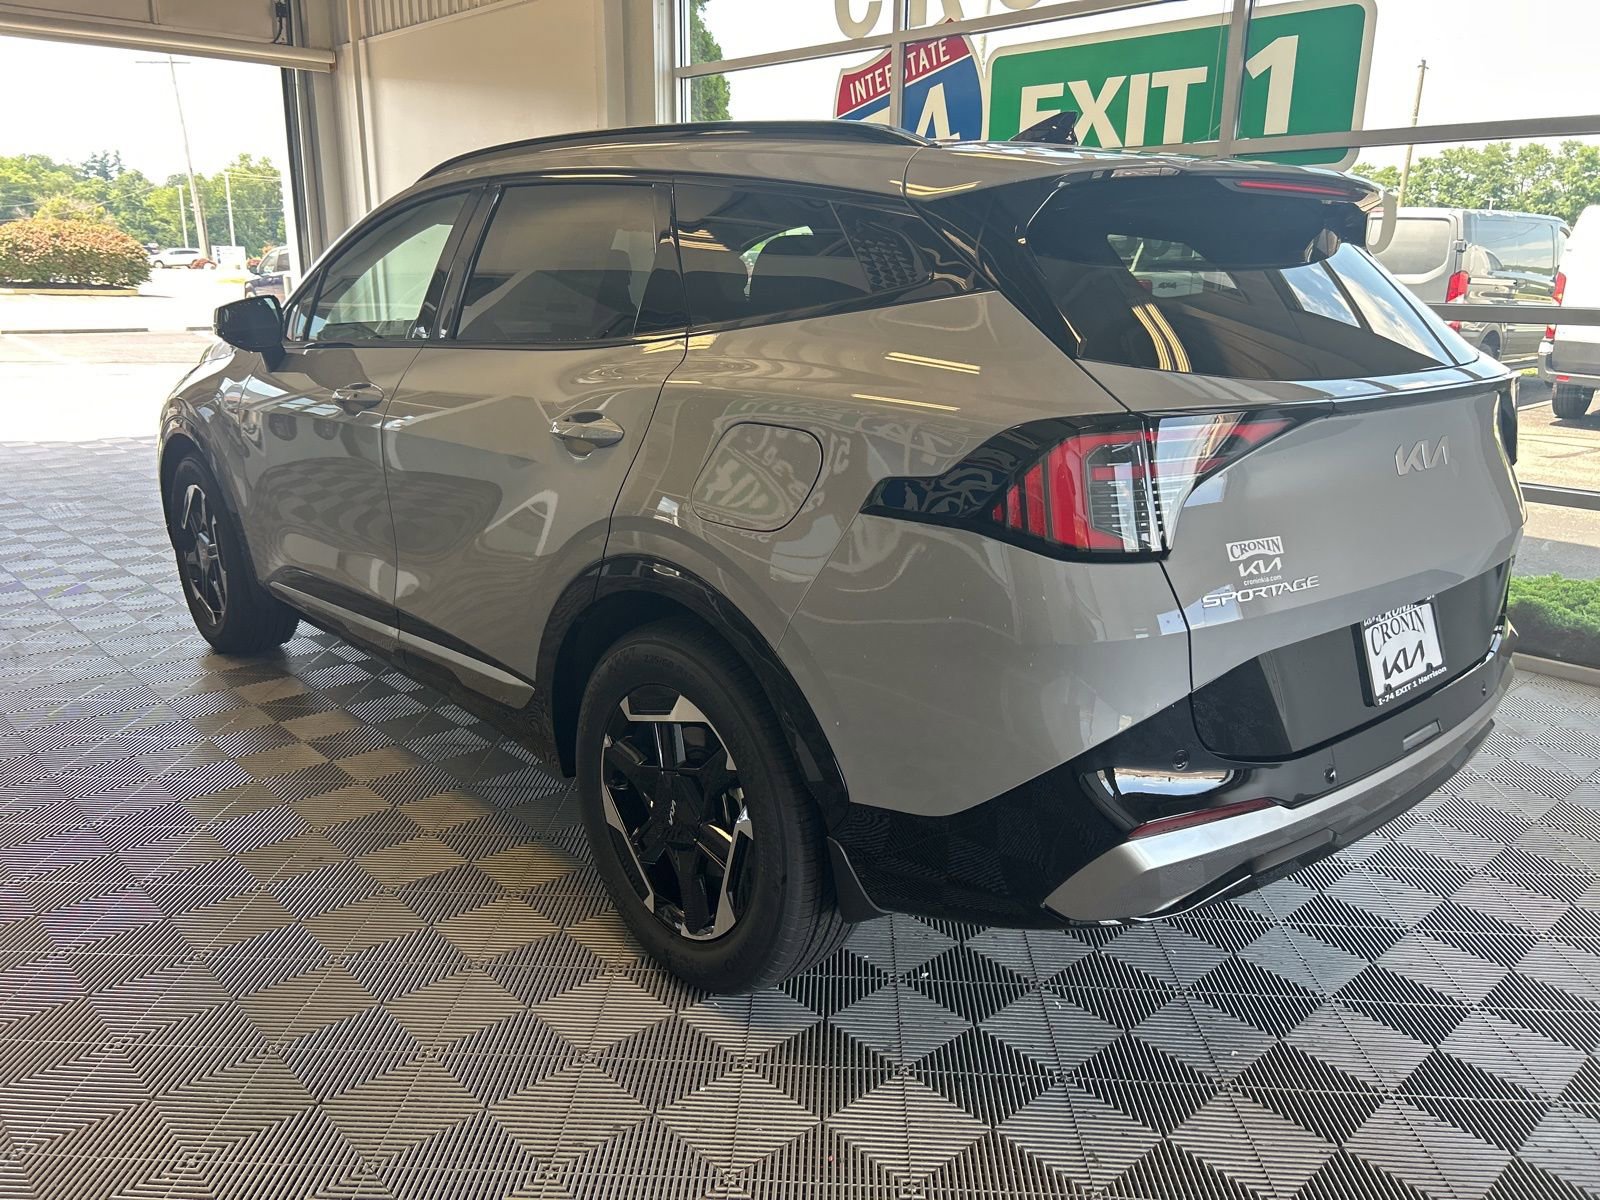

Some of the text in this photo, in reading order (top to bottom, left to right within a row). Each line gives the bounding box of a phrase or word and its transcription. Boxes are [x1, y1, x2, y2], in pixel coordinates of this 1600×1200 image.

[1019, 35, 1299, 148] EXIT 1
[1394, 435, 1449, 476] KIA
[1229, 537, 1281, 559] CRONIN
[1238, 557, 1282, 577] KIA
[1202, 575, 1320, 608] SPORTAGE
[1371, 606, 1426, 656] CRONIN
[1382, 640, 1425, 680] KIA
[1378, 692, 1395, 705] I-74
[1395, 683, 1412, 697] EXIT
[1418, 666, 1447, 684] Harrison
